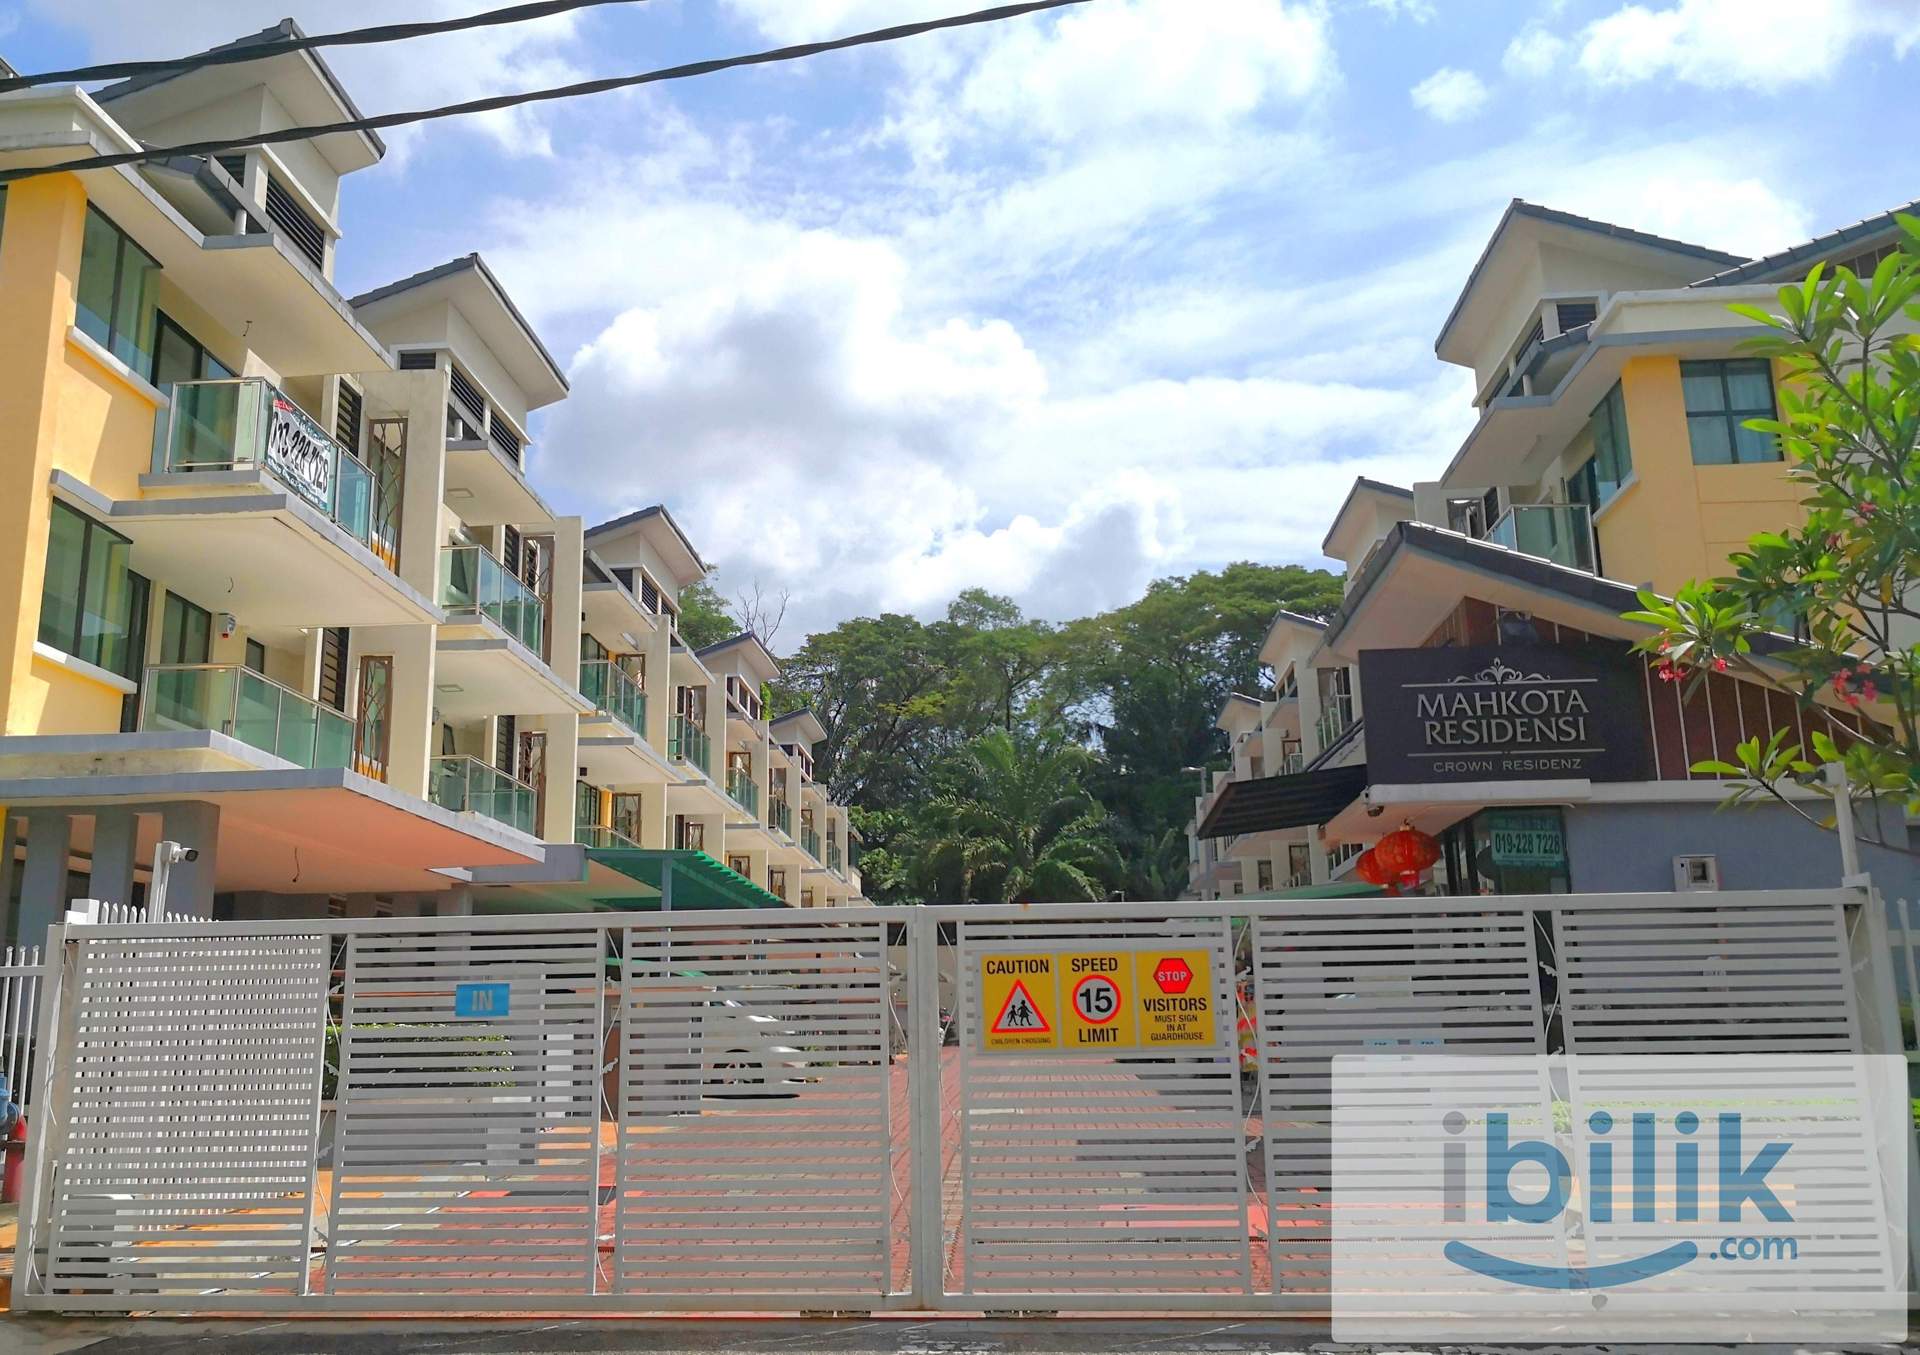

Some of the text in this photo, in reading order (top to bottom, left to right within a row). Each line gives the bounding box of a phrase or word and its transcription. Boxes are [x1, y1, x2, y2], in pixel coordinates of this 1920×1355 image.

[1416, 689, 1589, 718] MAHKOTA
[1424, 716, 1587, 745] RESIDENSI
[1433, 758, 1582, 773] CROWN RESIDENZ
[1536, 833, 1560, 855] 7228
[986, 959, 1050, 975] CAUTION
[1071, 957, 1118, 972] SPEED
[1158, 971, 1187, 982] STOP
[472, 990, 494, 1011] IN
[1080, 987, 1113, 1013] 15
[1143, 997, 1208, 1012] VISITORS
[1154, 1014, 1198, 1023] MUST SIGN
[1078, 1027, 1119, 1043] LIMIT
[1166, 1023, 1187, 1032] IN AT
[1150, 1032, 1205, 1041] GUARDHOUSE
